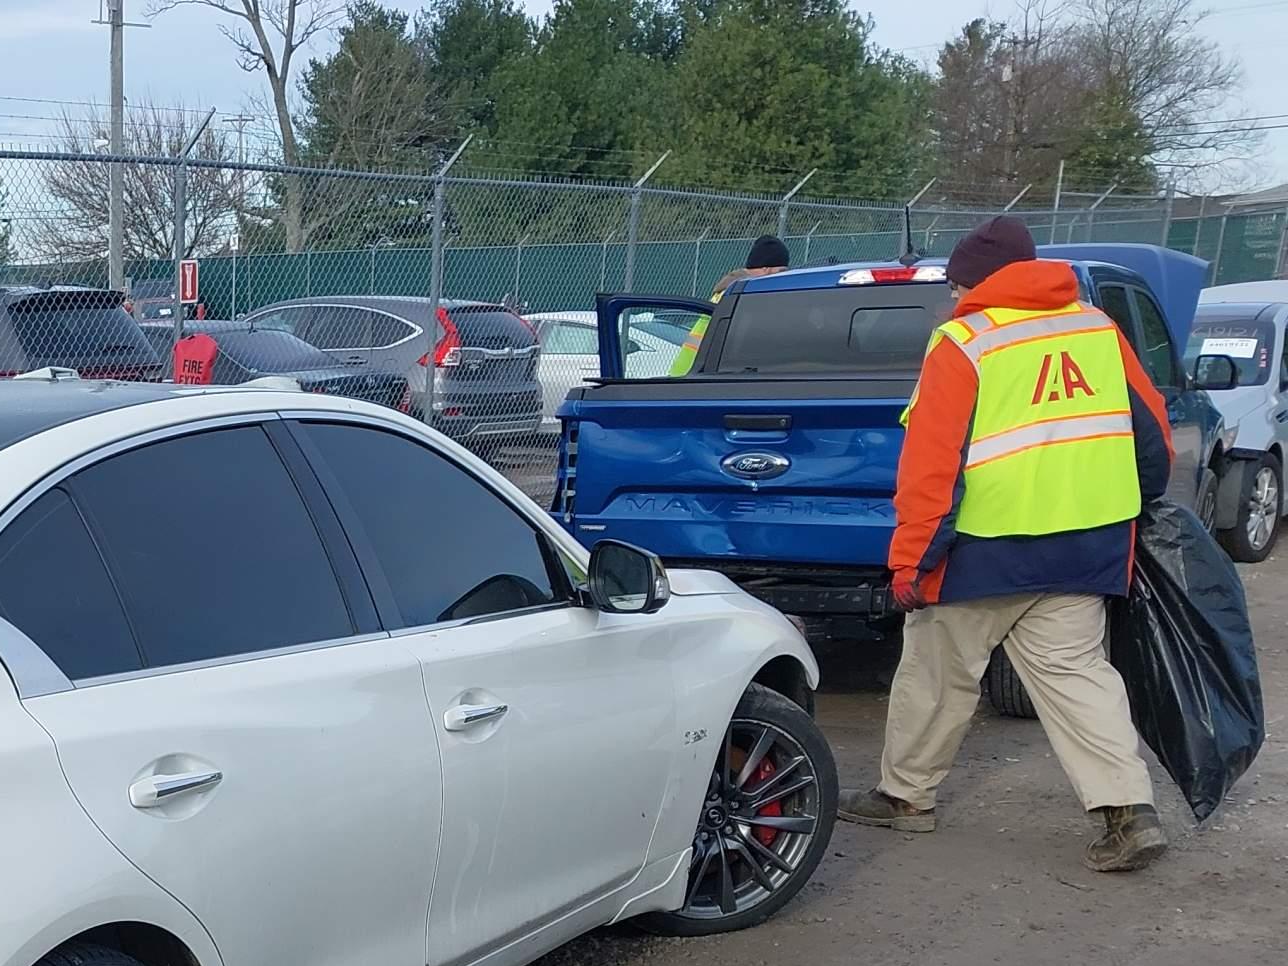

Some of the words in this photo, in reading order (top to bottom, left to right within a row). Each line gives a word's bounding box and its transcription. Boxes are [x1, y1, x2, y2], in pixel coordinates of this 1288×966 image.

[183, 360, 203, 374] FIRE
[736, 457, 768, 470] Ford
[625, 497, 890, 519] MAVERICK
